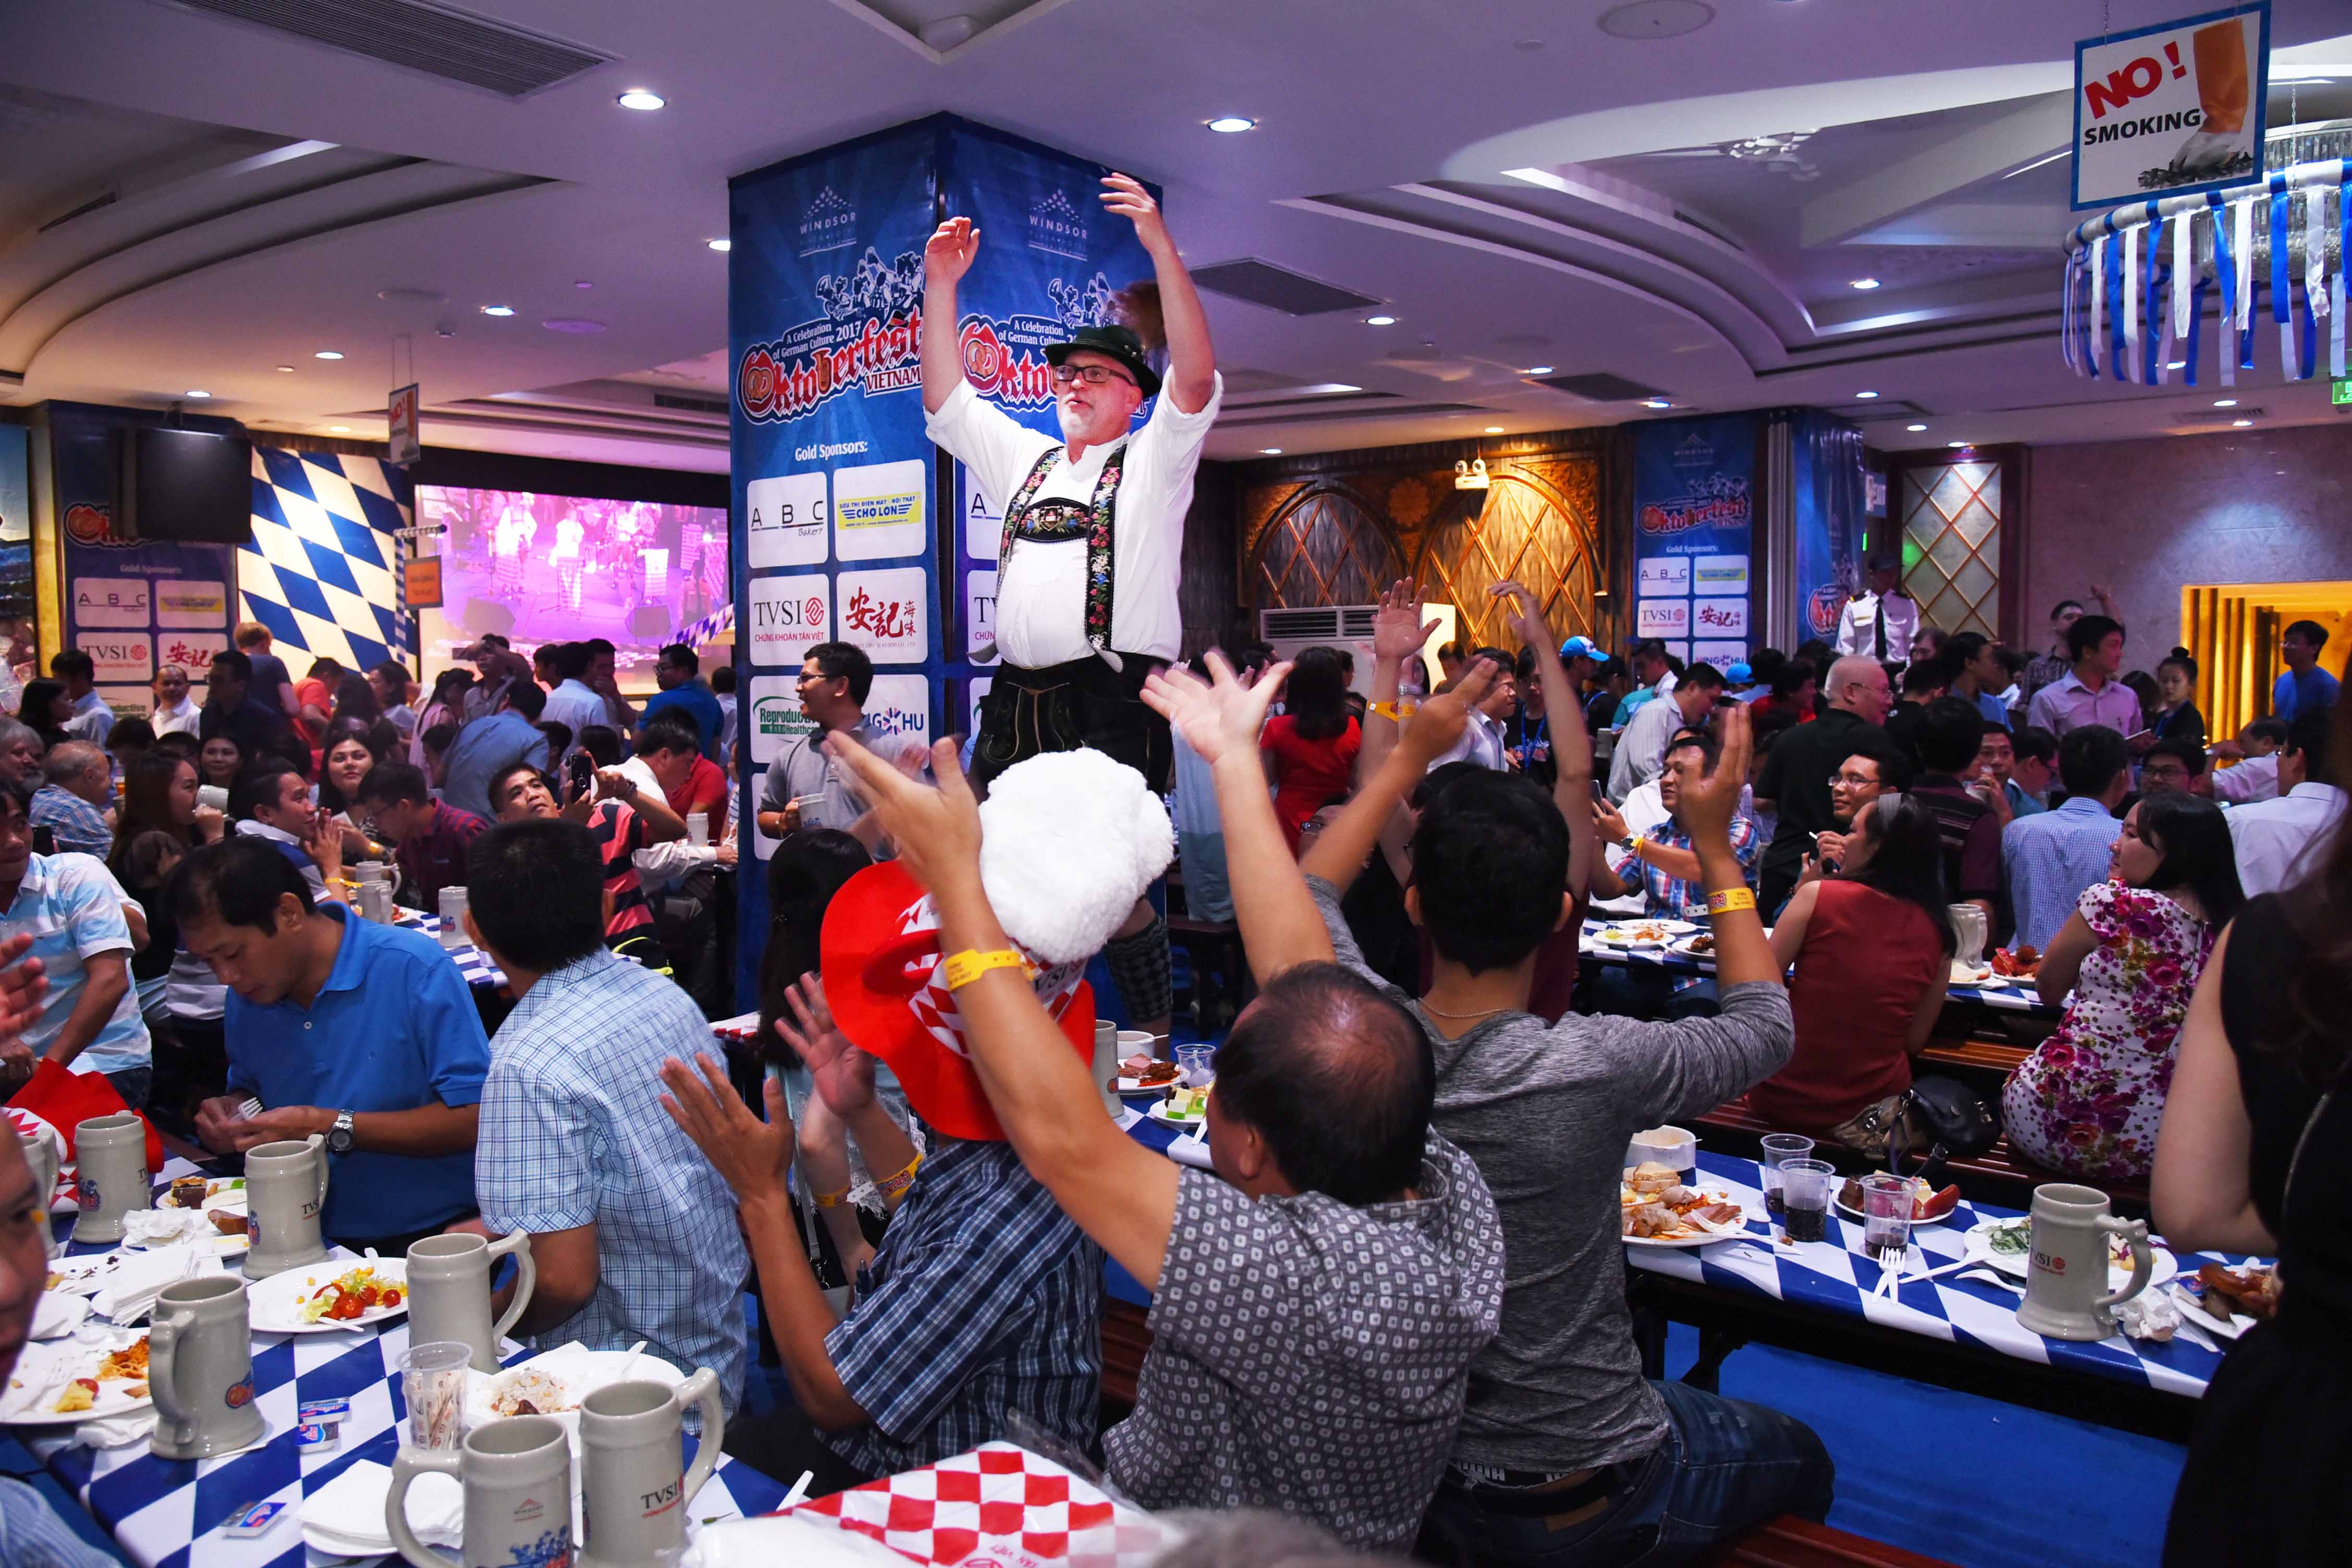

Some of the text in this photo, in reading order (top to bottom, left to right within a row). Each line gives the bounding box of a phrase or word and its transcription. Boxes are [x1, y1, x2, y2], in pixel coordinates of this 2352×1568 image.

[2084, 108, 2201, 146] SMOKING
[800, 212, 856, 234] WINDSOR
[1030, 215, 1087, 239] WINDSOR
[786, 323, 832, 345] A Celebration
[998, 330, 1007, 341] of
[1008, 333, 1038, 346] German
[1014, 320, 1064, 336] A Celebration
[773, 320, 862, 361] of German Culture 2017
[865, 367, 922, 391] VIETNAM
[795, 441, 868, 462] Gold Sponsors:
[1665, 545, 1683, 554] Gold
[754, 600, 802, 626] TVSI
[846, 586, 904, 639] 安記
[1642, 609, 1671, 621] TVSI
[641, 1481, 678, 1510] TVSI
